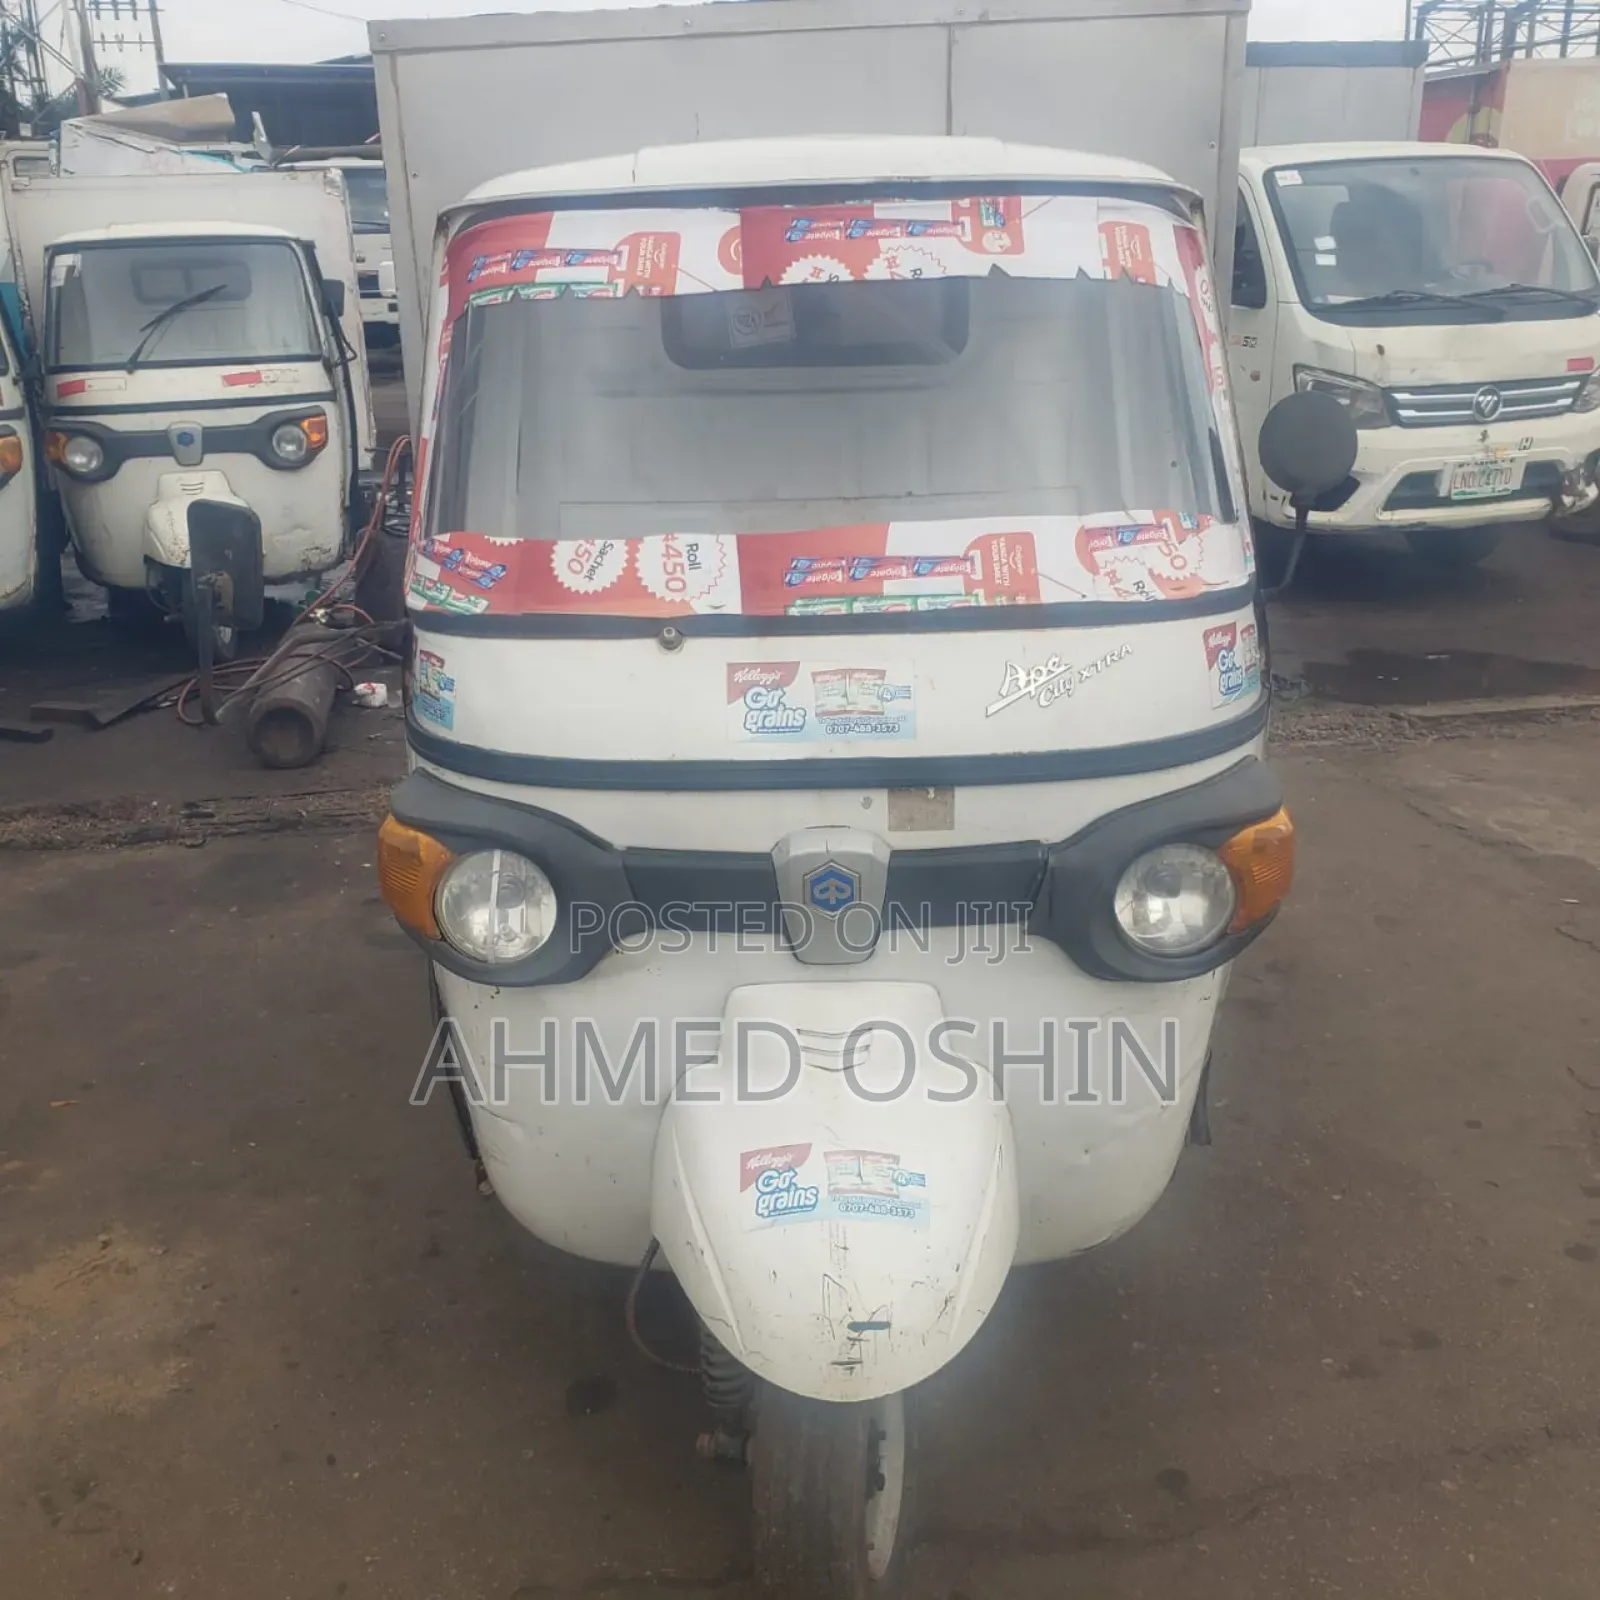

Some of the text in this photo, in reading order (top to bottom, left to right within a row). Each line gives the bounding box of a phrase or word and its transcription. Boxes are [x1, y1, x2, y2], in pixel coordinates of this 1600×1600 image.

[583, 540, 614, 583] Sachet
[684, 542, 702, 571] Roll
[733, 667, 783, 685] Kellogg's
[999, 653, 1062, 700] Ape
[1038, 643, 1133, 708] City XTRA
[744, 685, 785, 710] Go
[744, 704, 807, 734] grains
[745, 1153, 795, 1171] Kellogg's
[756, 1167, 798, 1192] Go
[756, 1184, 819, 1219] grains
